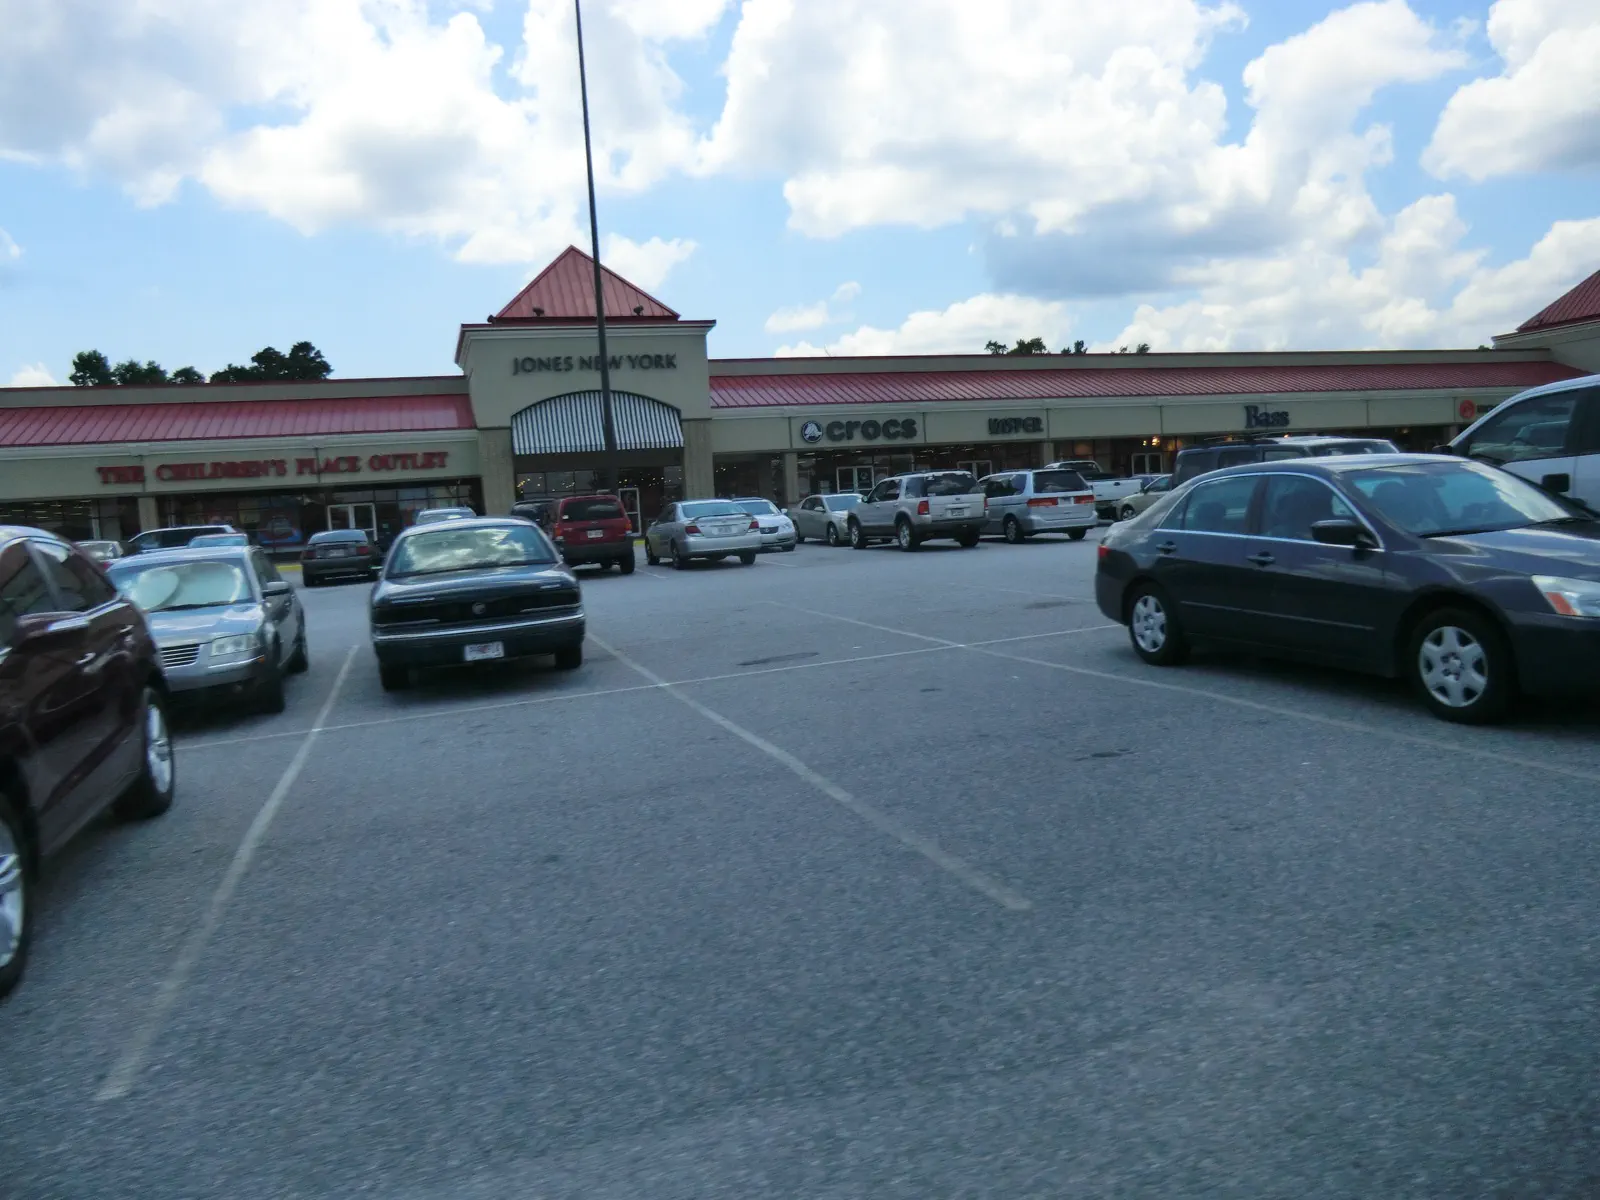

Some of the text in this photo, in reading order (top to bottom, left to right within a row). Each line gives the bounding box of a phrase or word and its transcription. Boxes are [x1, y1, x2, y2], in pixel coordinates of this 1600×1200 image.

[513, 353, 678, 376] JONES NEW YORK
[1244, 404, 1290, 429] Bass
[826, 418, 918, 442] crocs
[96, 451, 449, 484] THE CHILDREN'S PLACE OUTLET
